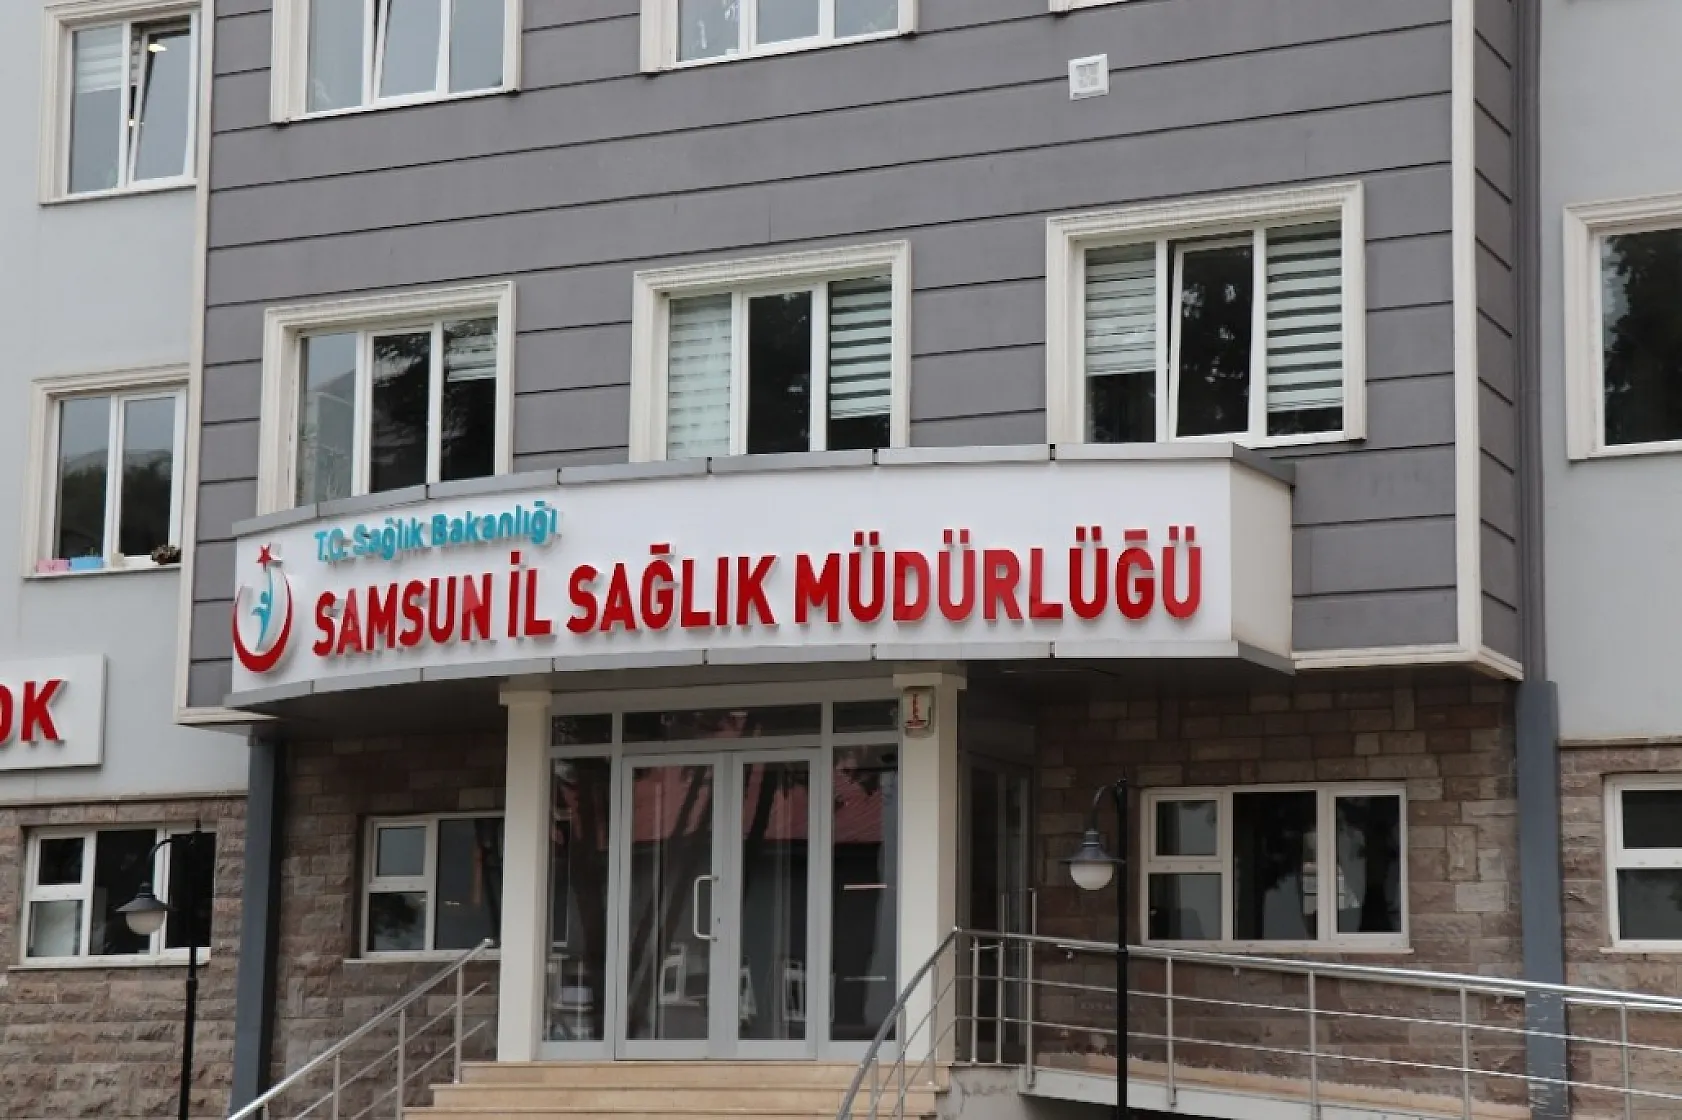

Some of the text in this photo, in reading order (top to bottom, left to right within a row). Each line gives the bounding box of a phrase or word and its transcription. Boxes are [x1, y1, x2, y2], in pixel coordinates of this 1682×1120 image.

[352, 517, 425, 561] Sağlık
[431, 499, 558, 547] Bakanlığı
[313, 526, 1202, 657] SAMSUN İL SAĞLIK MÜDÜRLÜĞÜ
